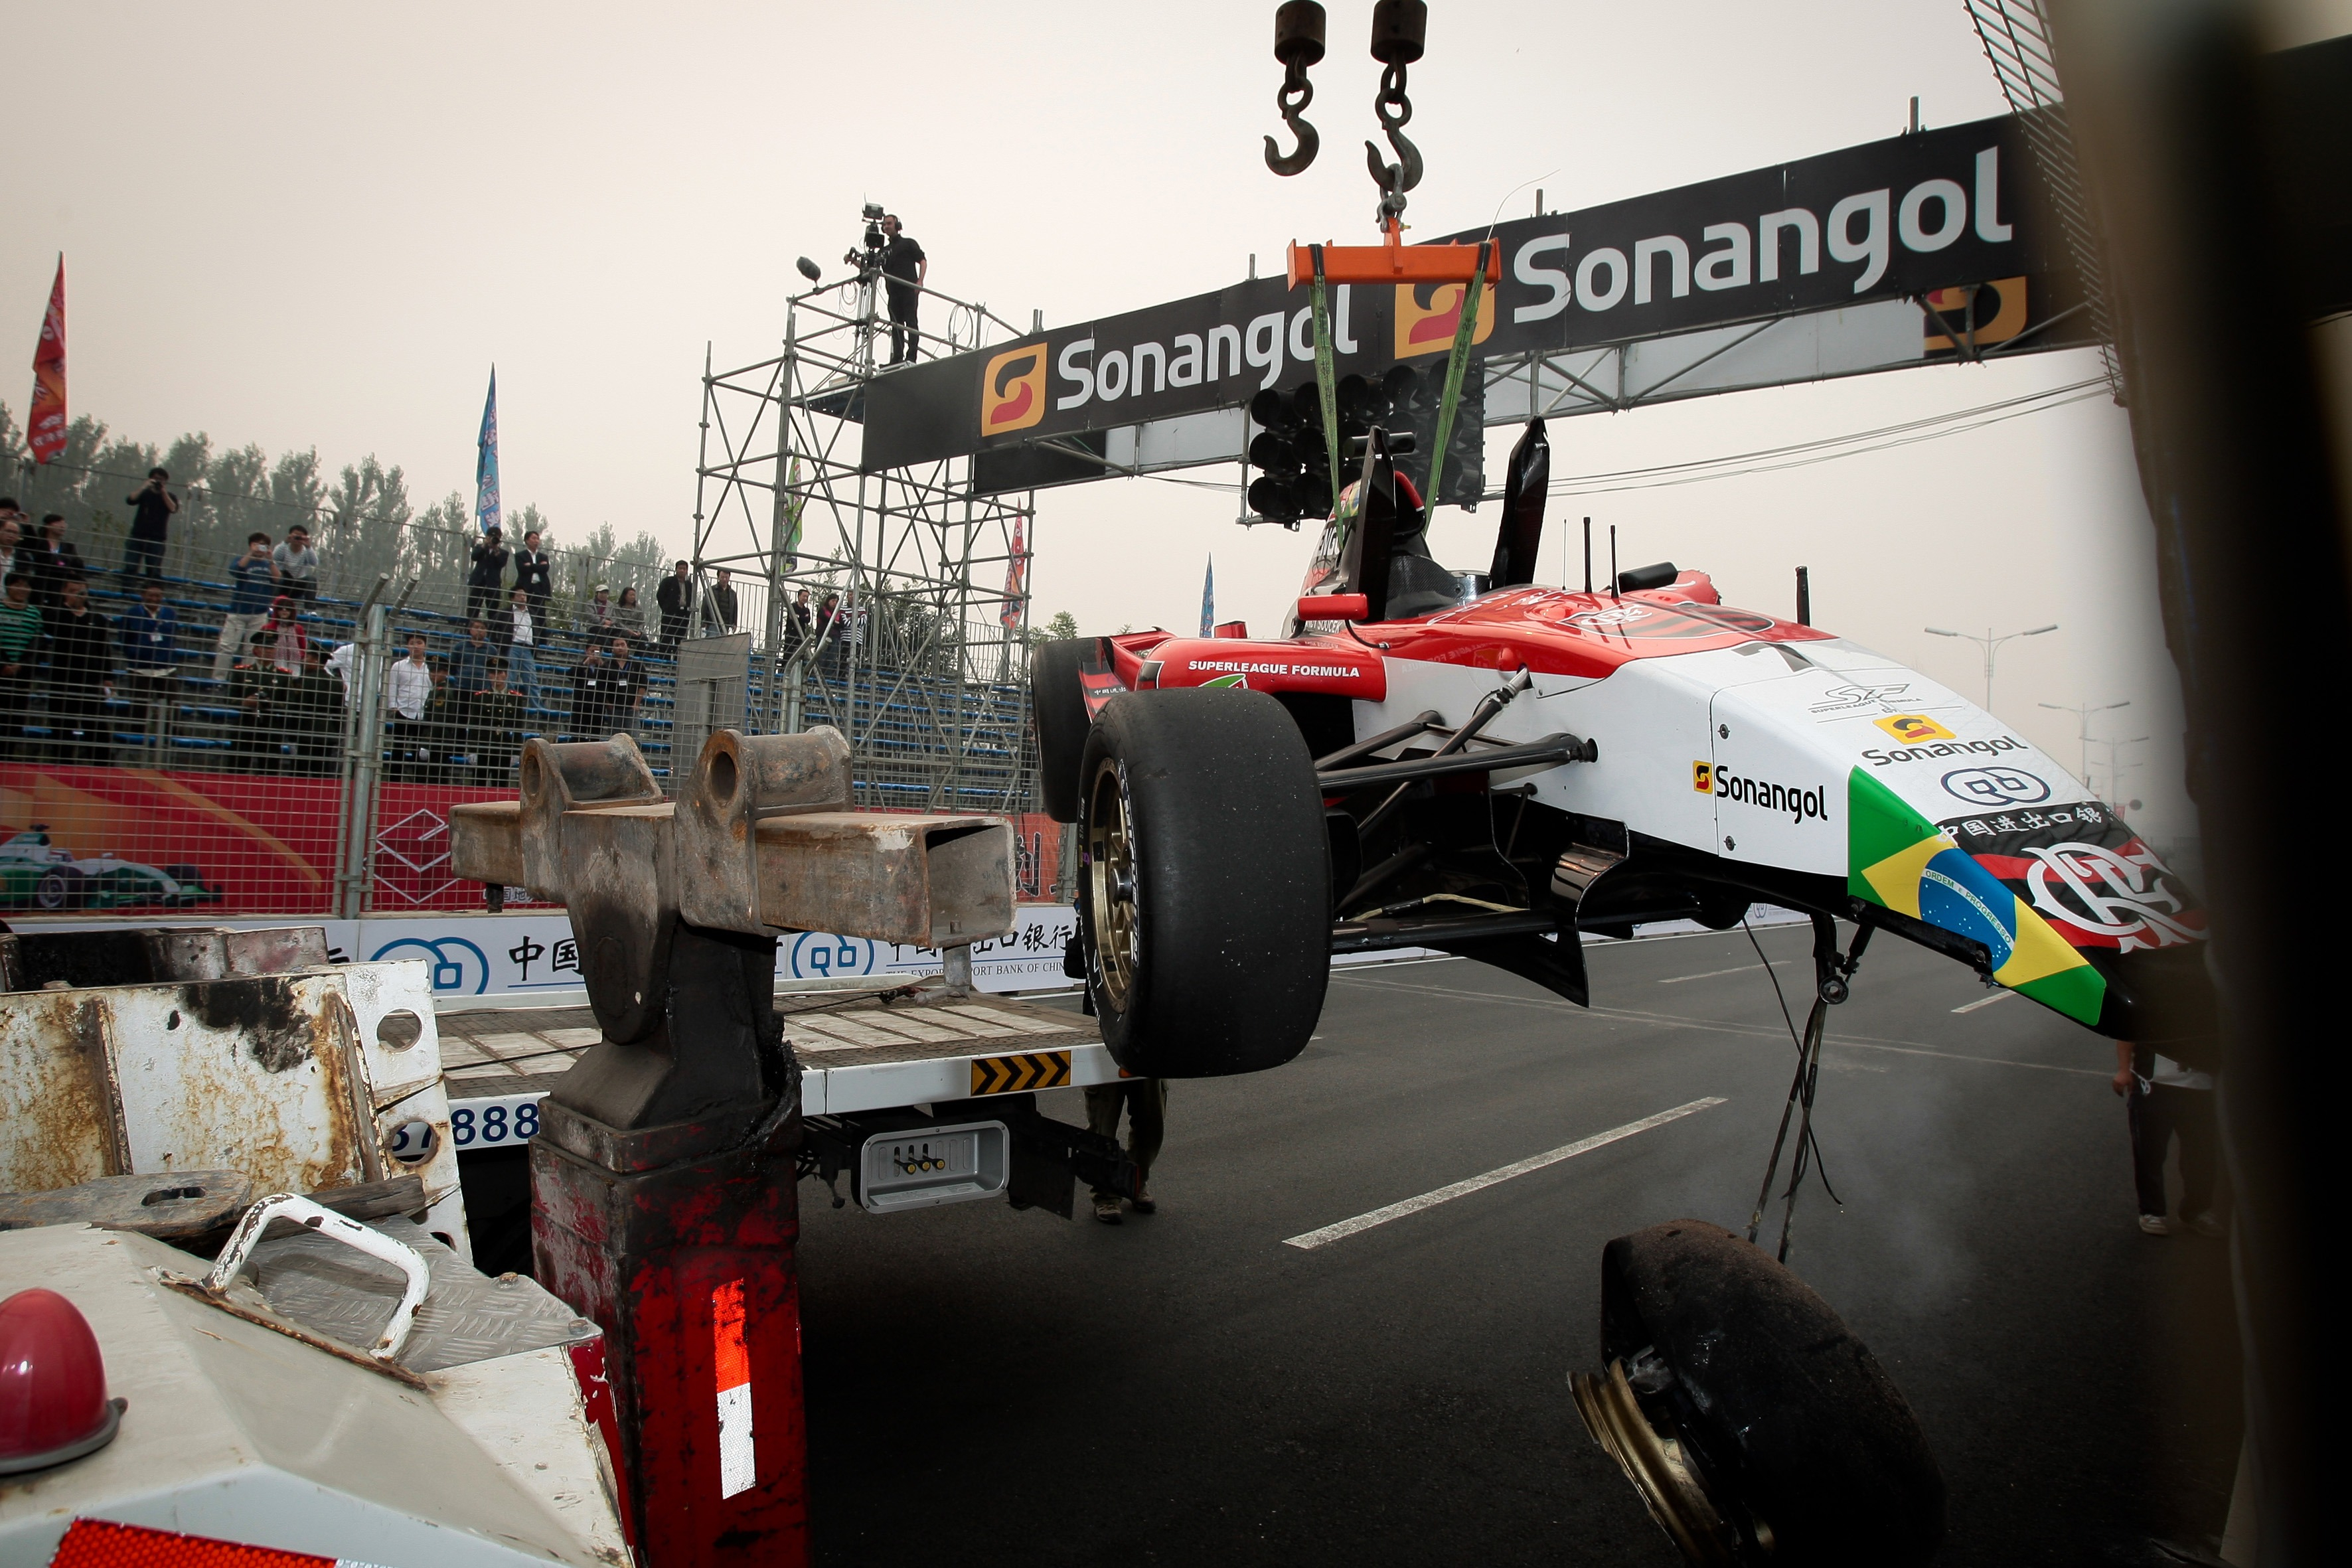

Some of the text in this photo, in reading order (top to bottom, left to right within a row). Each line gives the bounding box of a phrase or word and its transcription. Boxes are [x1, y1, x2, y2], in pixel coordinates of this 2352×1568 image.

[1513, 145, 2013, 324] Sonangol
[1057, 283, 1358, 411] Sonangol
[1188, 661, 1360, 678] SUPERLEAGUE FORMULA
[1861, 736, 2029, 767] Sonangol
[1715, 765, 1828, 824] Sonangol
[1936, 805, 2114, 846] 中国进出口银
[1924, 870, 1954, 889] ORDEM
[1965, 892, 2012, 944] PROGRESSO
[996, 964, 1024, 975] BANK
[1027, 963, 1040, 973] OF
[1043, 962, 1064, 973] CHIN
